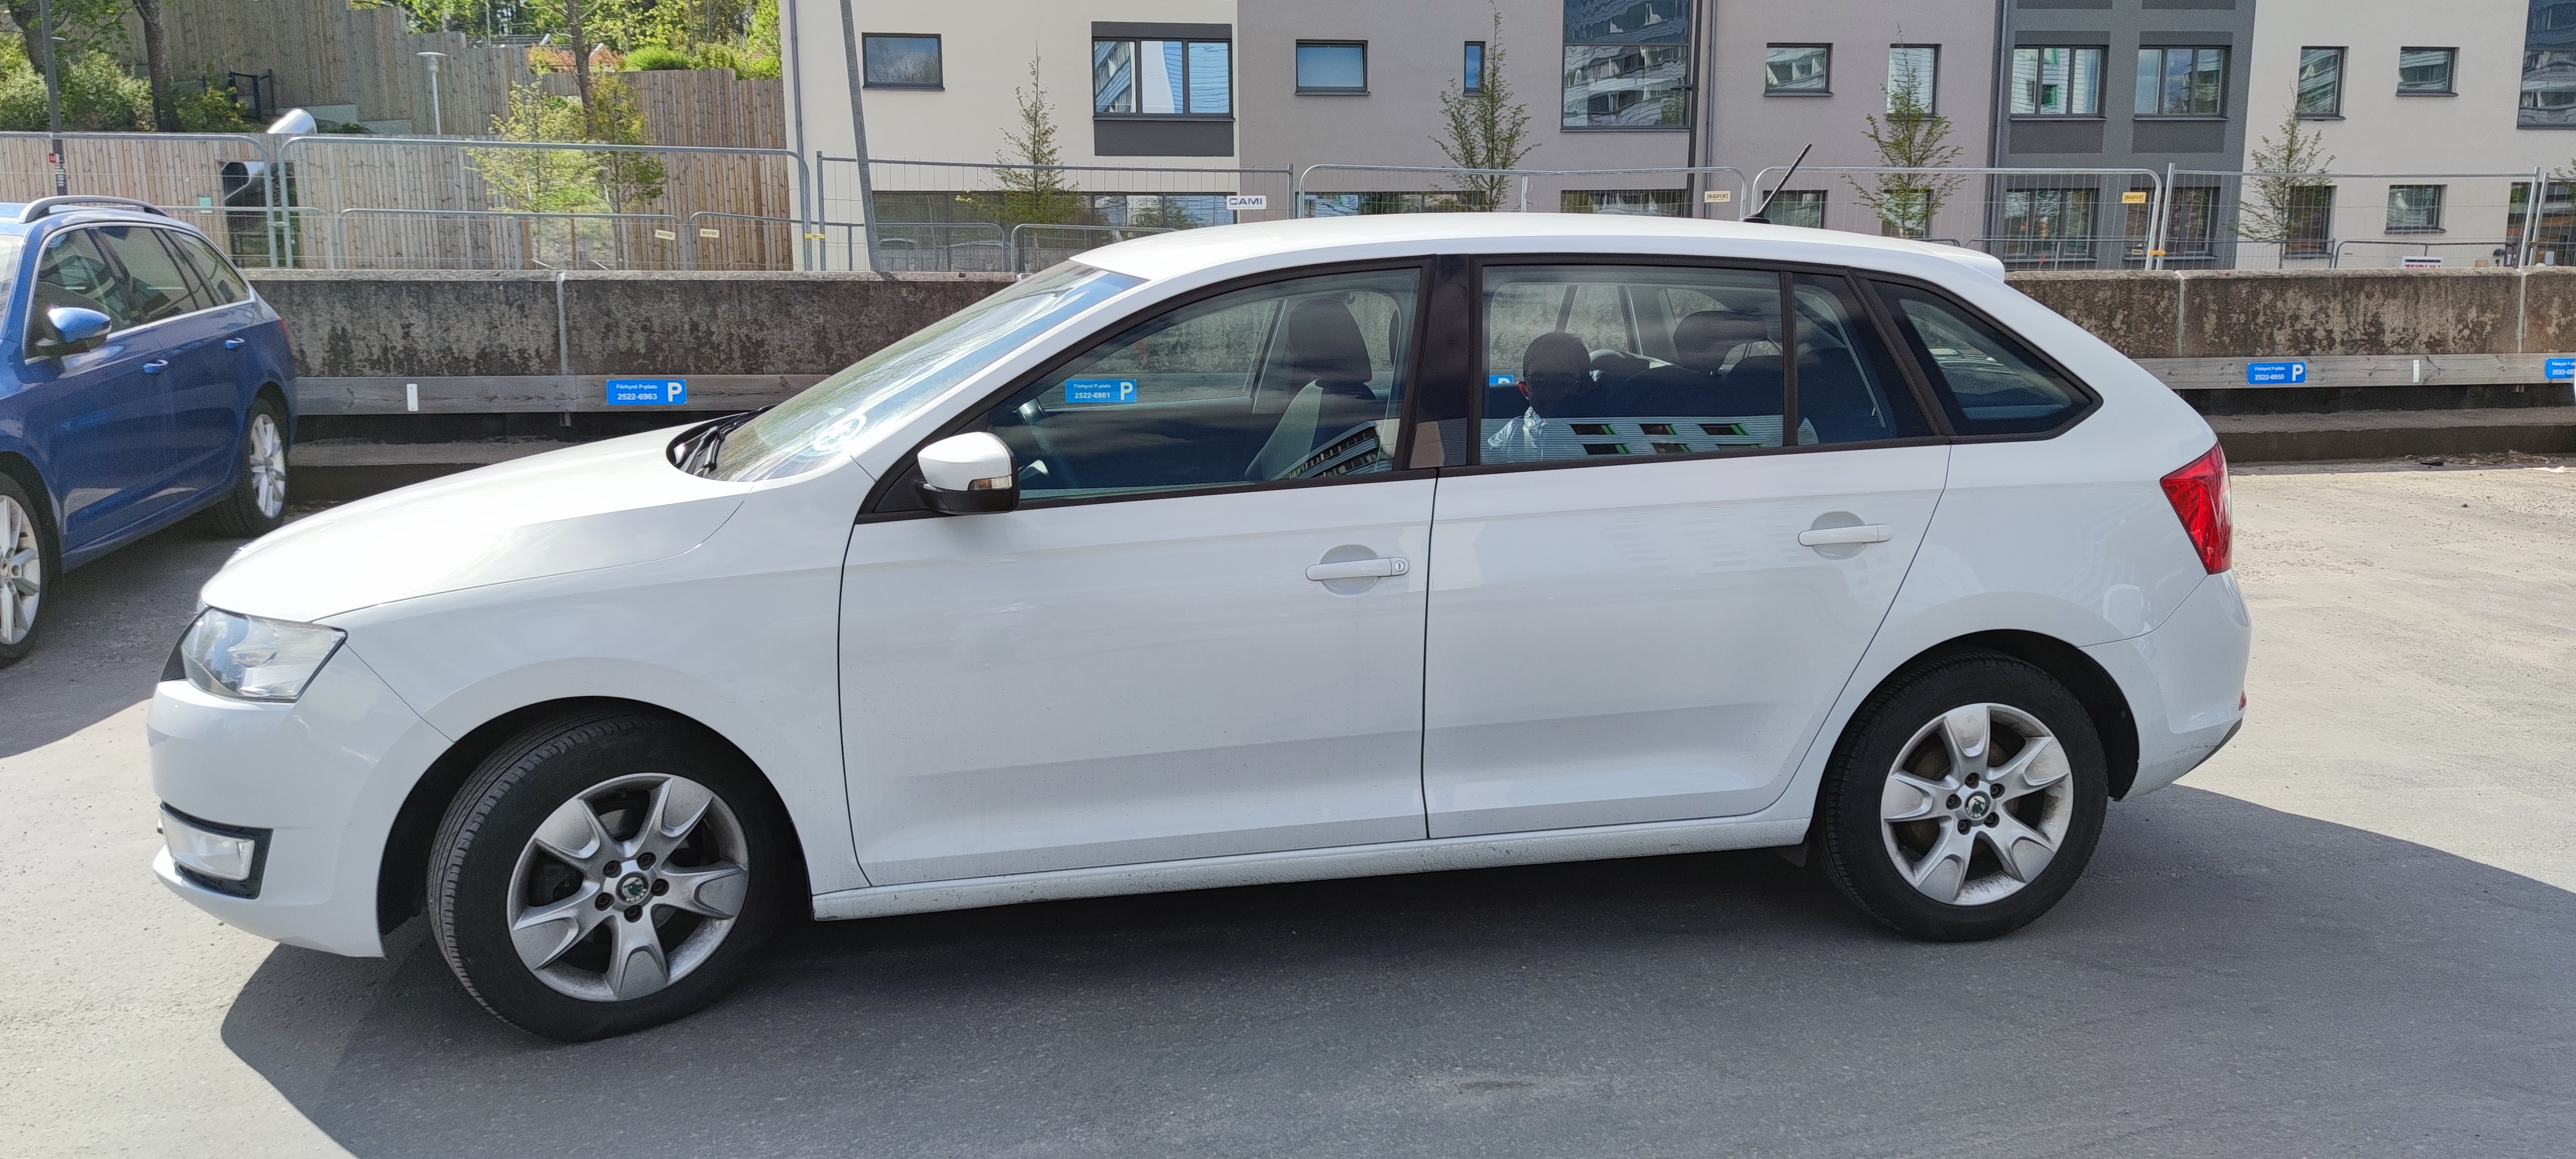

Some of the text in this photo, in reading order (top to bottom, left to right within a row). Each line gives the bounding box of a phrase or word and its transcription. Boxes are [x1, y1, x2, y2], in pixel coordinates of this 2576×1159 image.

[2292, 364, 2304, 381] P
[668, 382, 683, 402] P
[1120, 382, 1133, 401] P
